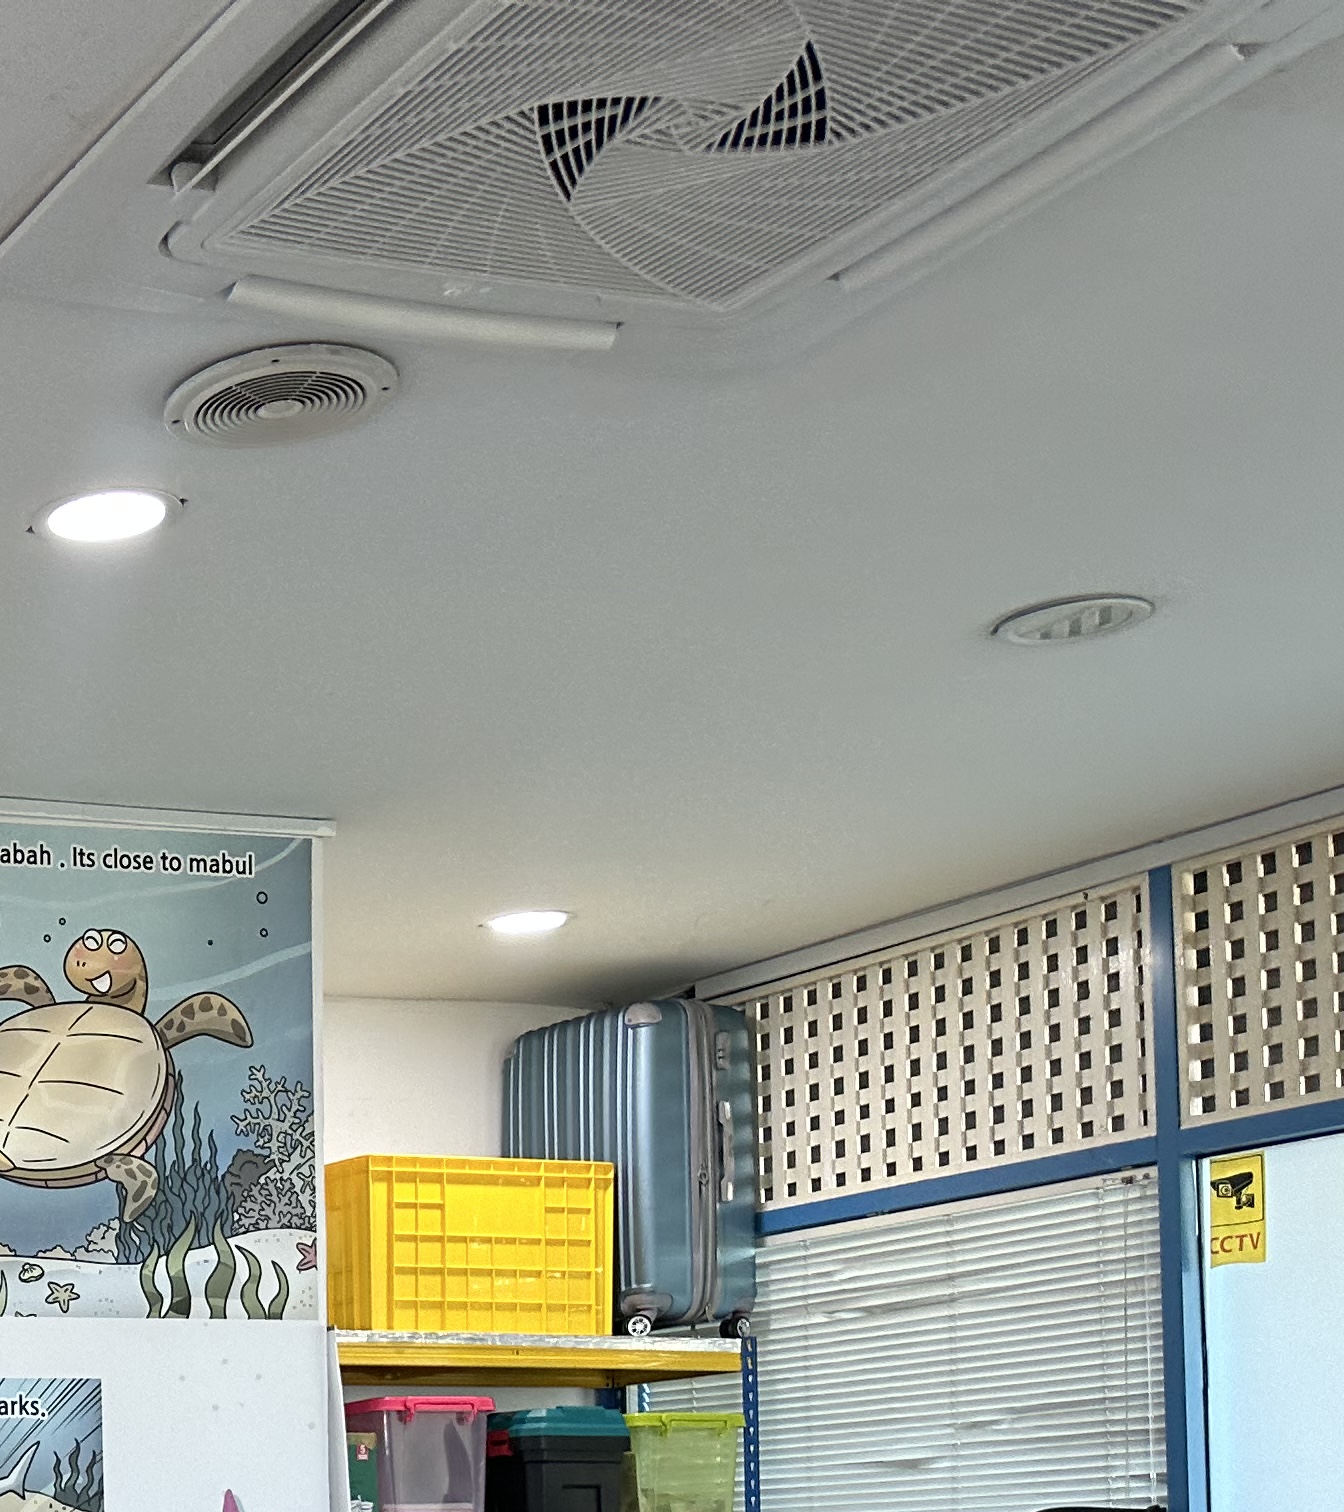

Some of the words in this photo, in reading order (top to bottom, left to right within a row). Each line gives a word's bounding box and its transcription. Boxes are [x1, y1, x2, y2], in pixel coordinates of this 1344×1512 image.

[72, 846, 96, 868] Its
[102, 847, 154, 871] close
[159, 851, 182, 872] to
[189, 852, 253, 876] mabul
